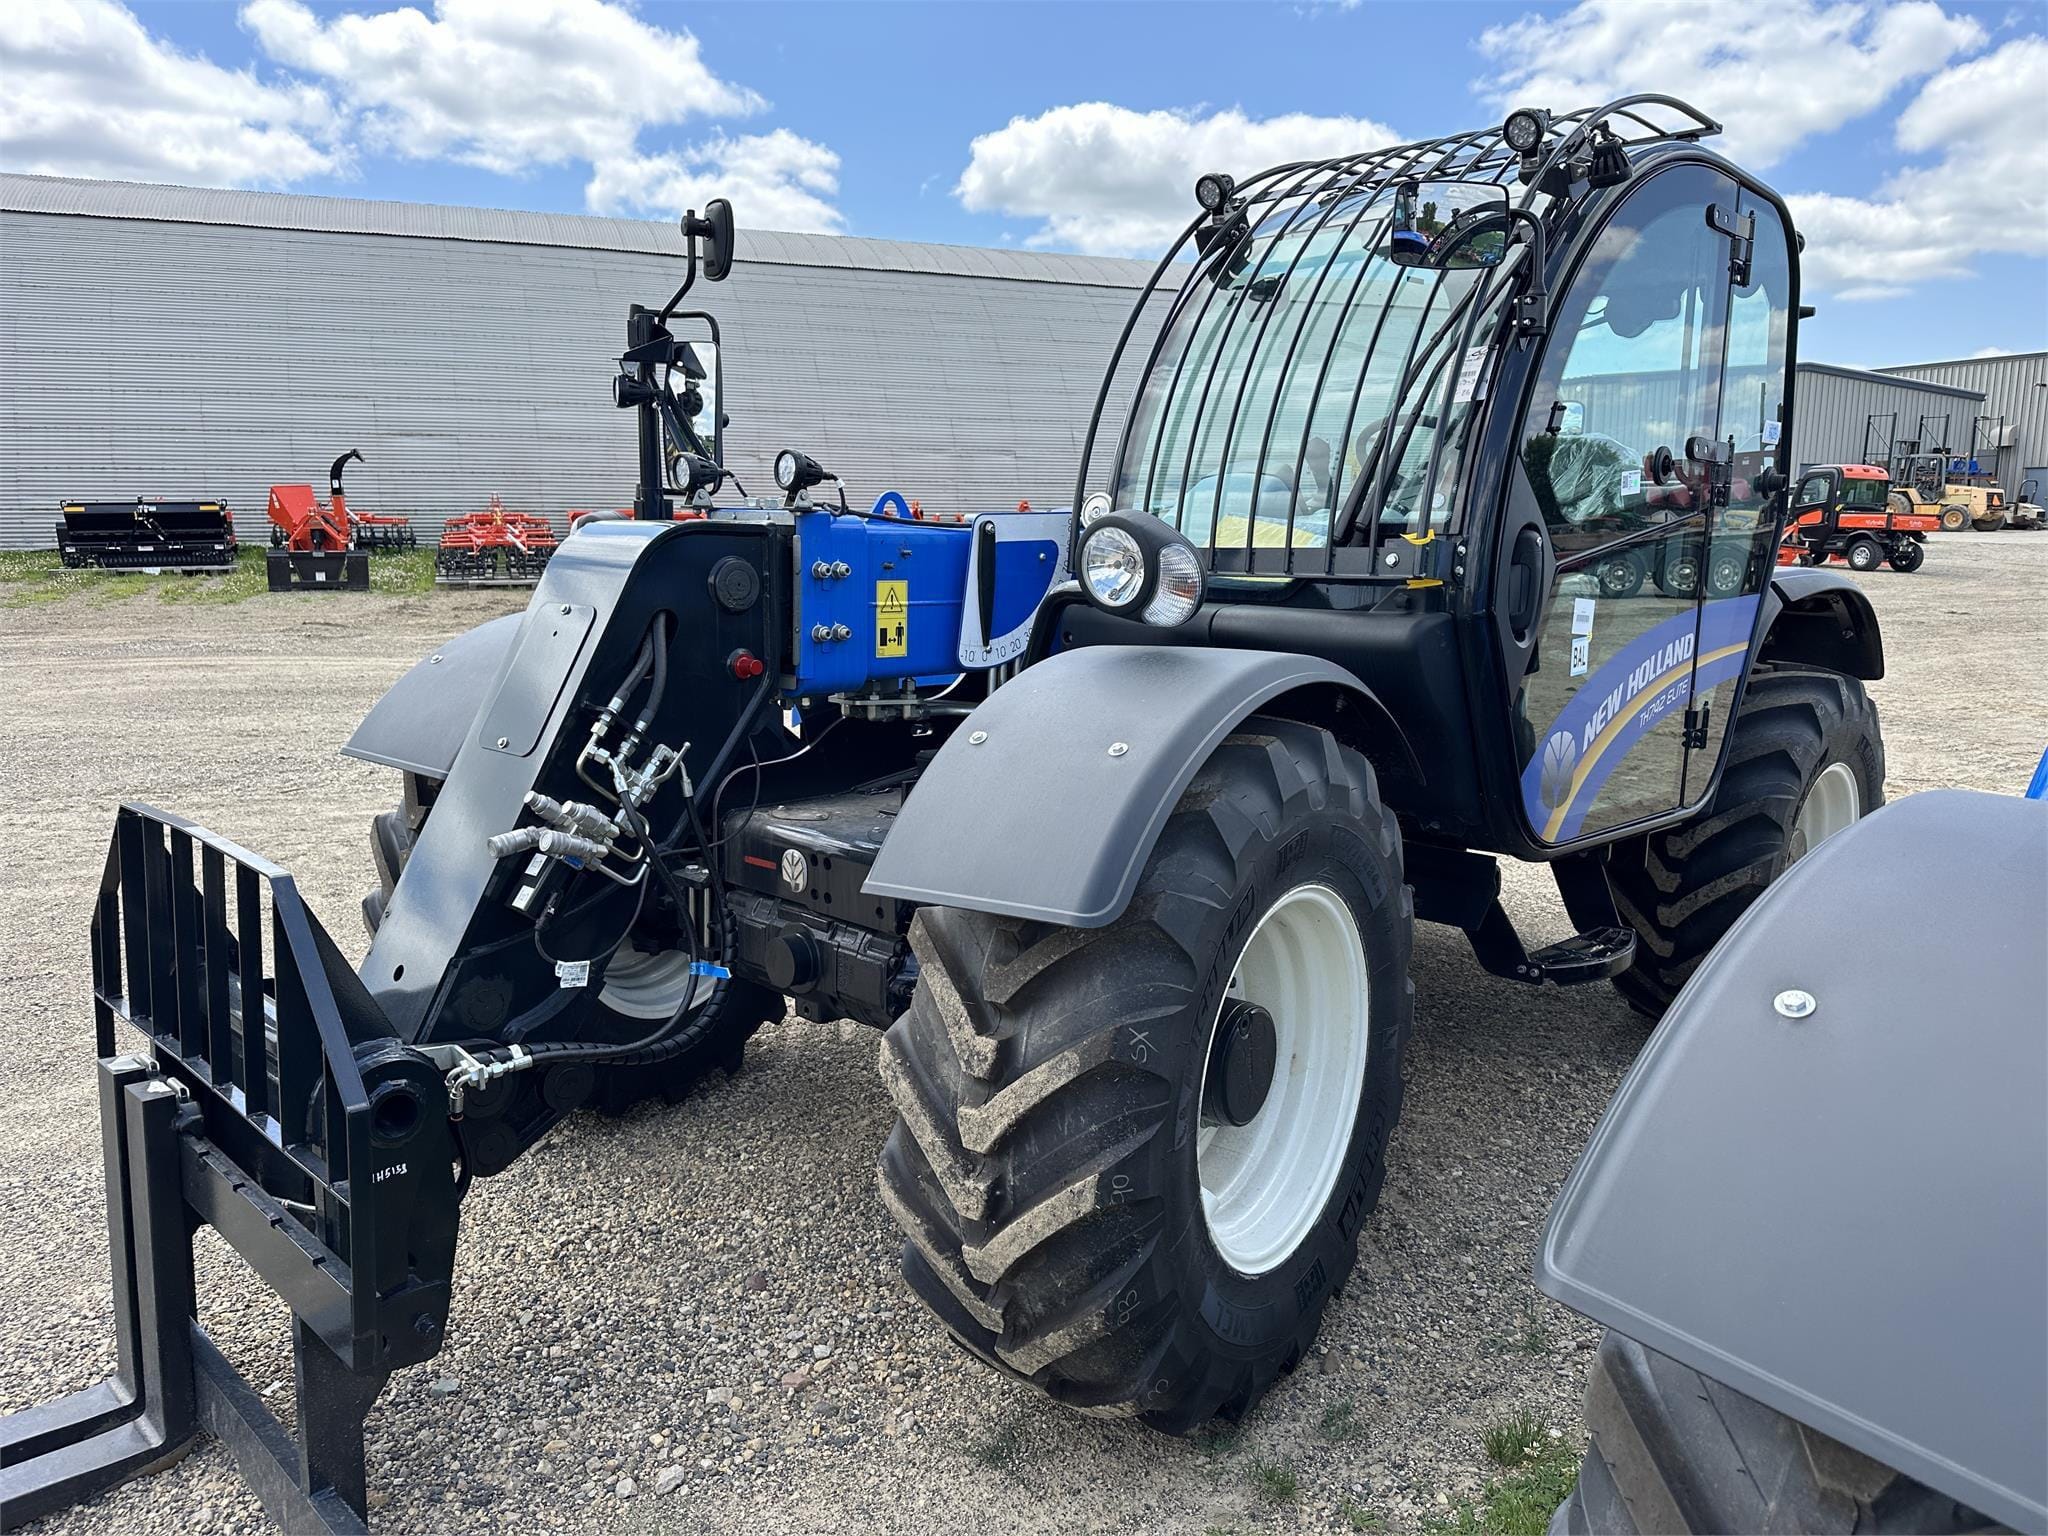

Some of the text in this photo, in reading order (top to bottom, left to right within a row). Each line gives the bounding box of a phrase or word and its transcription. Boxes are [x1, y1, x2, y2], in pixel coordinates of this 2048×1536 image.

[996, 646, 1007, 659] 10
[1010, 638, 1021, 652] 20
[1583, 633, 1696, 753] NEW HOLLAND
[1666, 679, 1689, 705] ELITE
